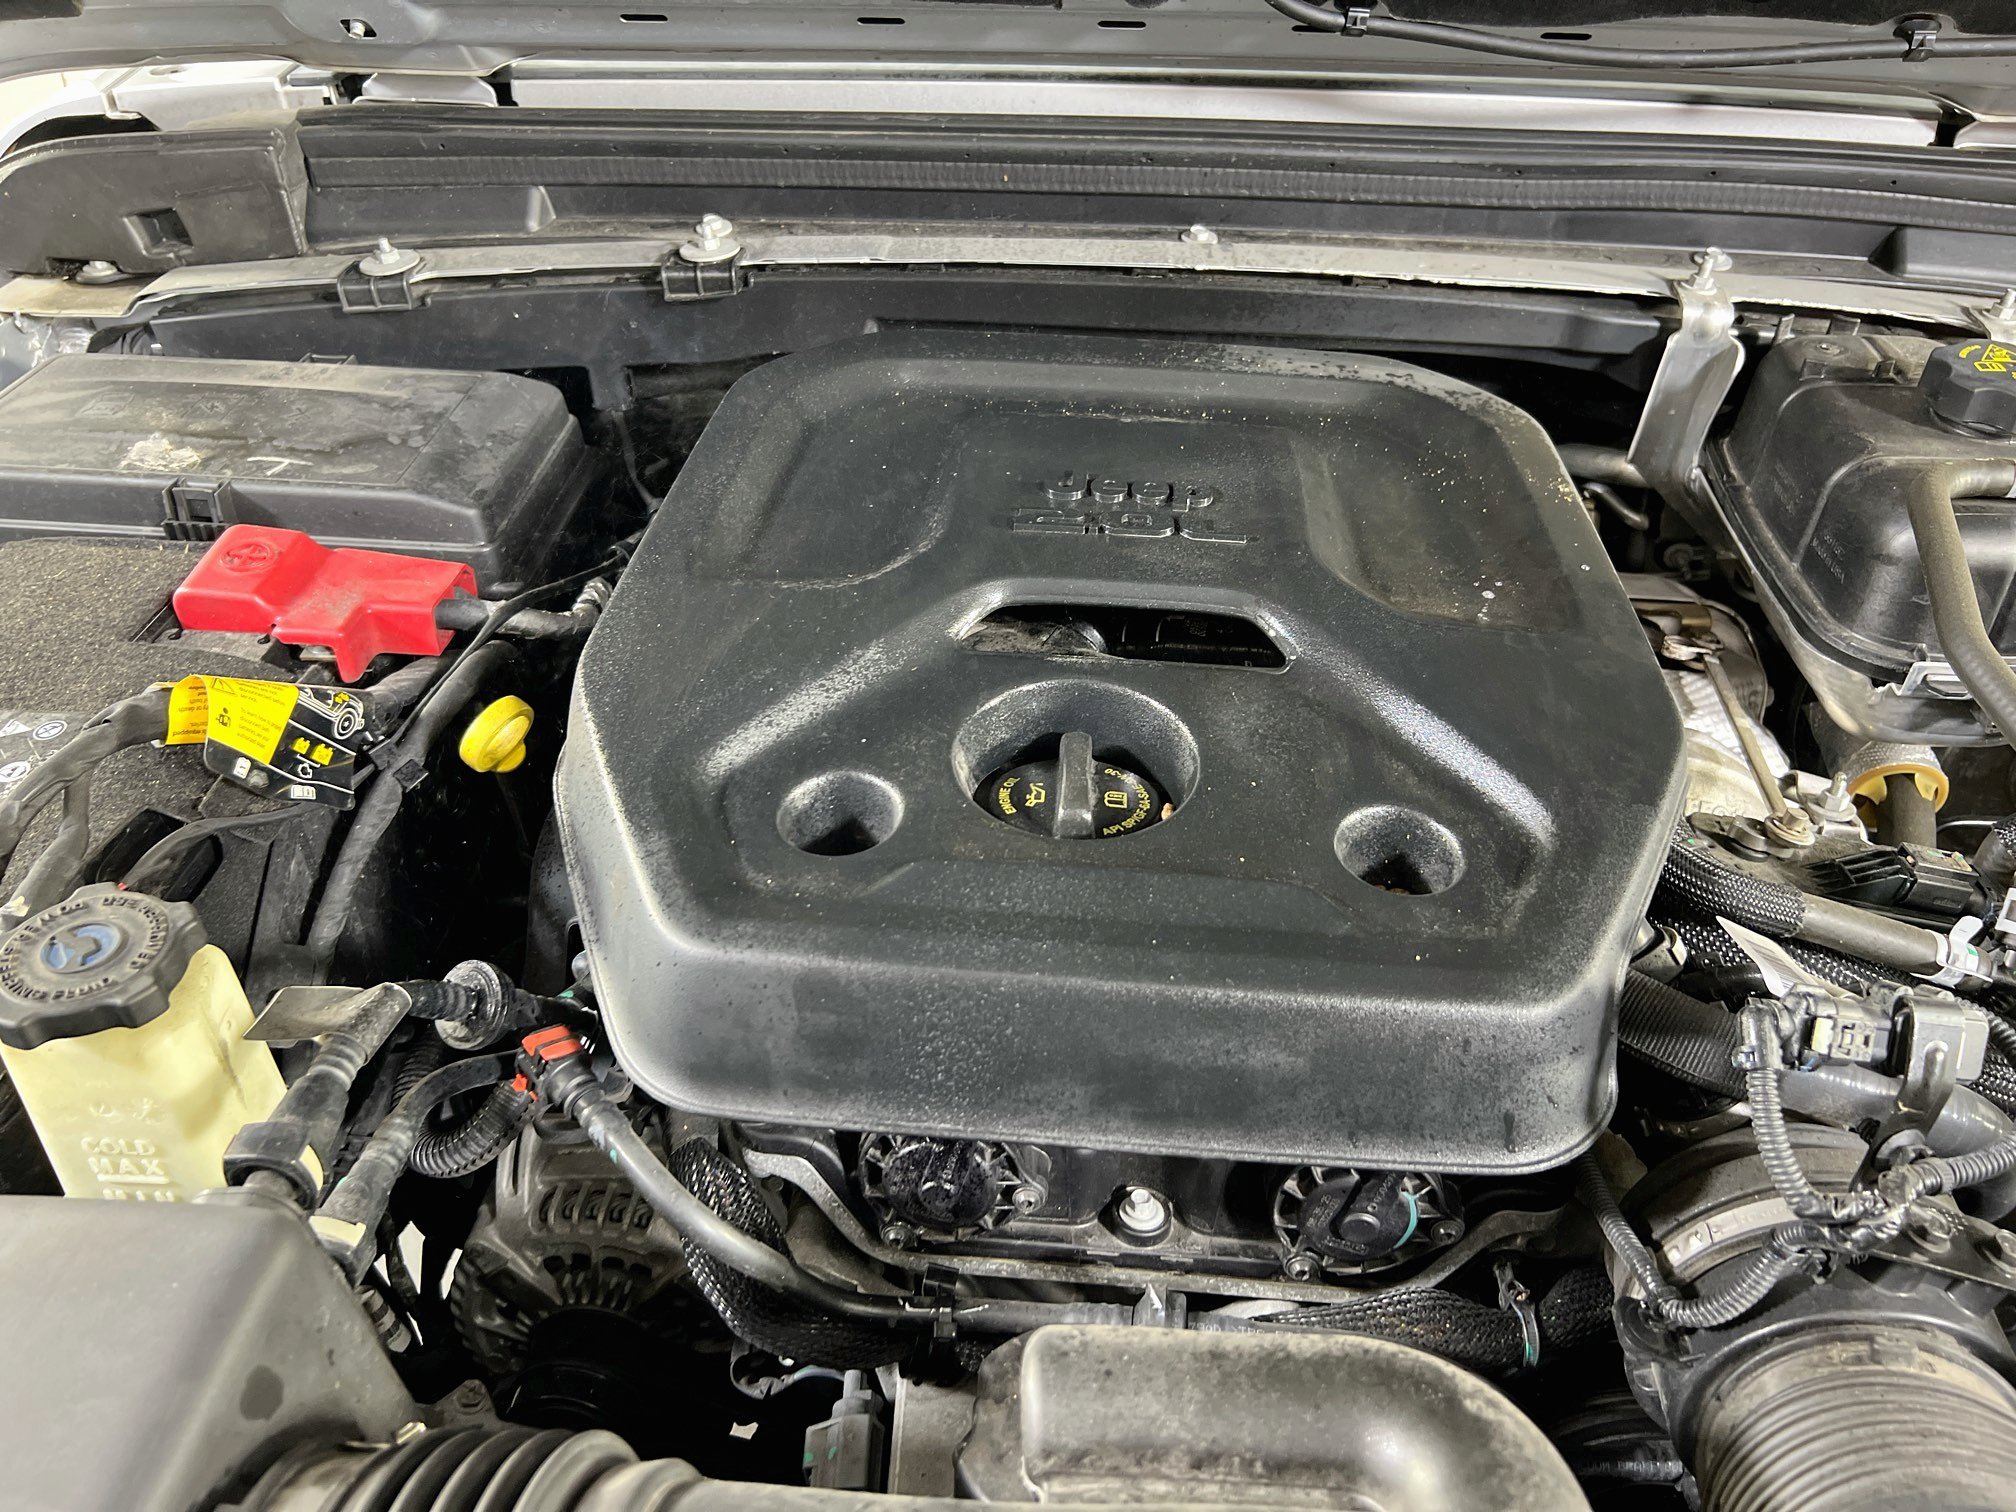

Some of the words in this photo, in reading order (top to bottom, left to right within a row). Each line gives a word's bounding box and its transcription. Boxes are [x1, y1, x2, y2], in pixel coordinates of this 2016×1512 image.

[1046, 471, 1214, 513] Jeep
[1004, 777, 1021, 789] OIL
[999, 787, 1017, 815] ENGINE
[1102, 824, 1124, 836] API
[13, 901, 86, 943] POWER
[0, 945, 49, 1000] STEERING
[52, 976, 112, 1000] FLUID
[81, 1136, 155, 1156] COLD
[88, 1157, 164, 1175] MAX
